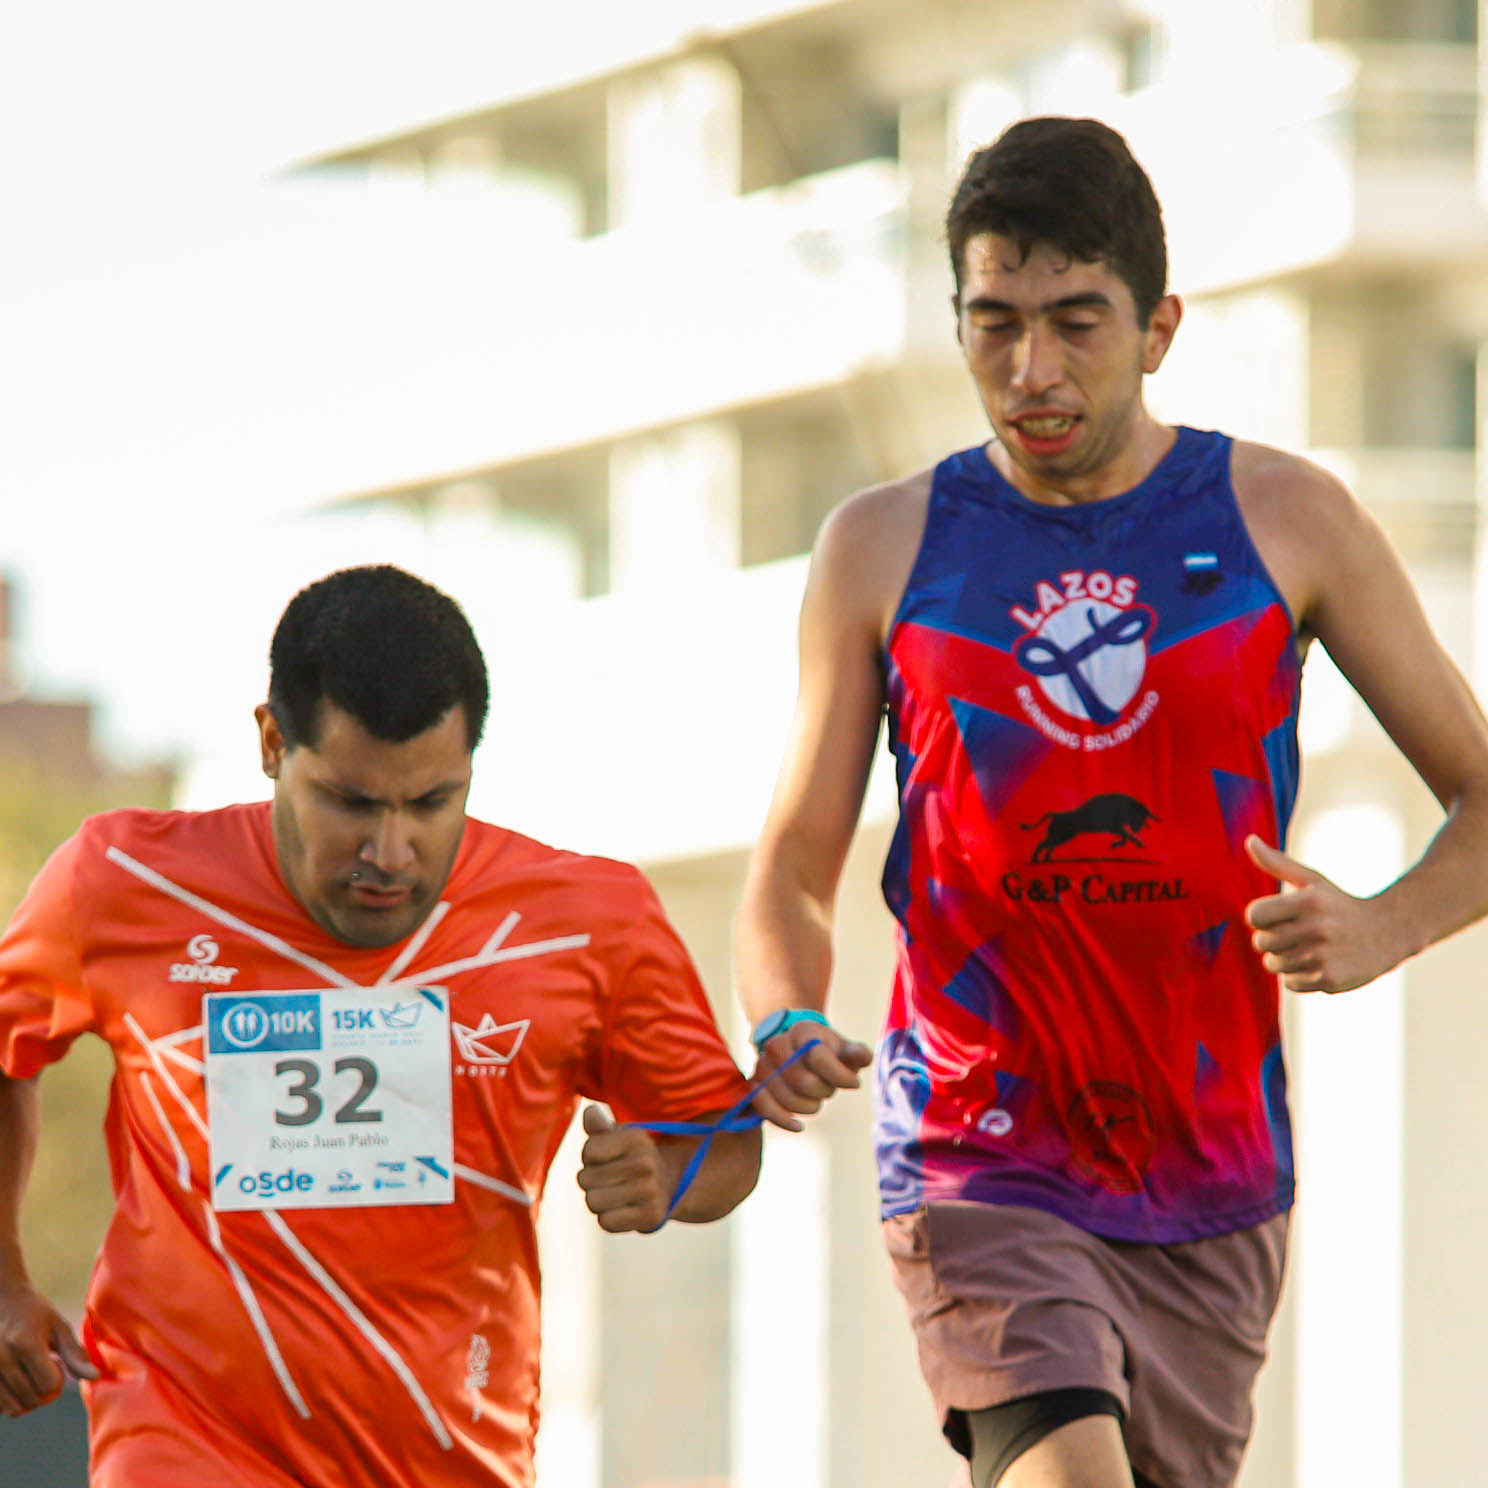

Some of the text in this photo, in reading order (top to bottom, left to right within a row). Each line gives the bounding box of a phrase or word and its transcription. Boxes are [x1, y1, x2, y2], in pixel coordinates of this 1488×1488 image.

[1012, 571, 1137, 630] LAZOS
[1016, 685, 1160, 751] RUNNING SOLIDARIO
[1001, 872, 1073, 902] G&P
[271, 1009, 375, 1035] 10K 15K
[274, 1055, 384, 1127] 32
[239, 1167, 315, 1198] osde
